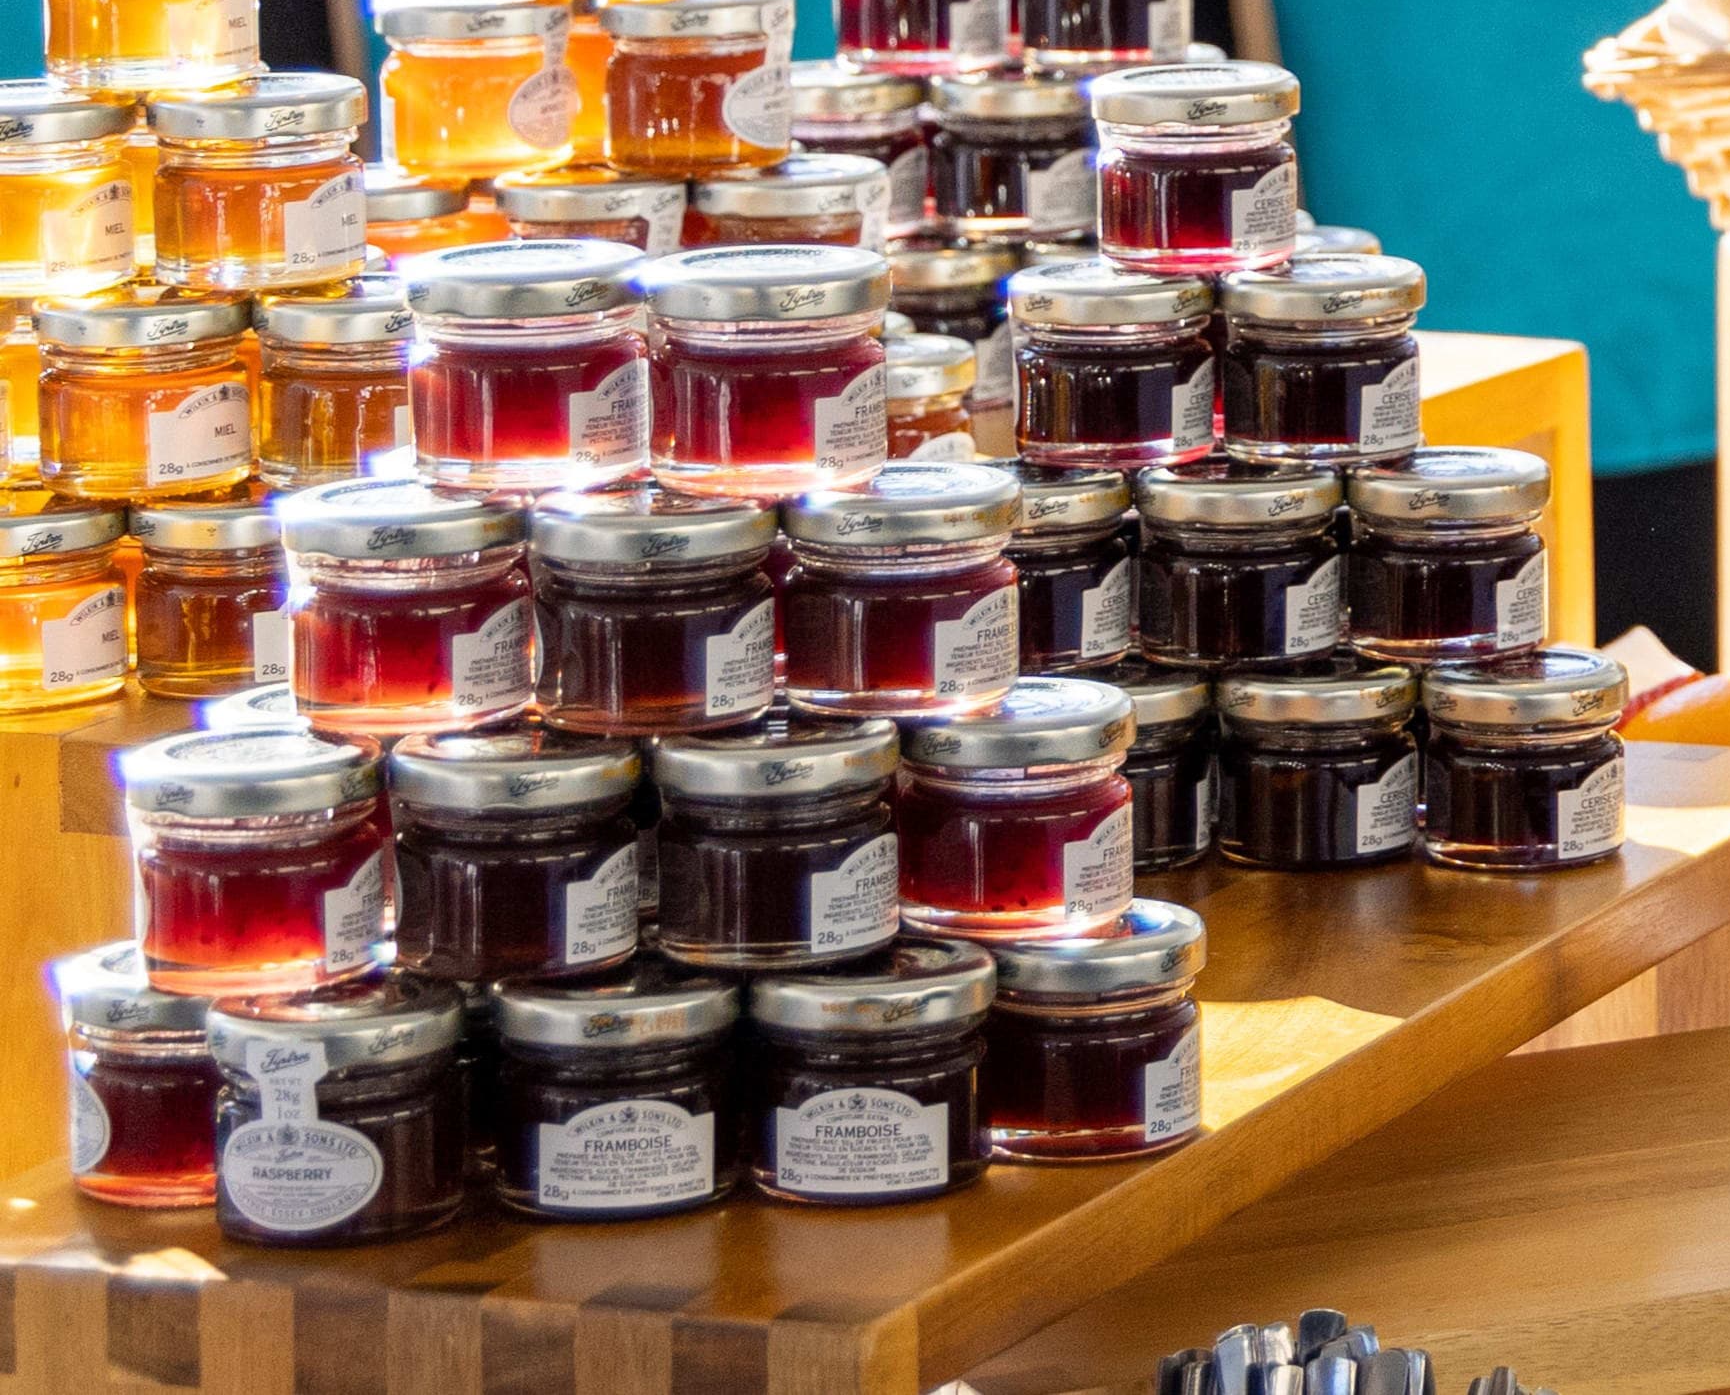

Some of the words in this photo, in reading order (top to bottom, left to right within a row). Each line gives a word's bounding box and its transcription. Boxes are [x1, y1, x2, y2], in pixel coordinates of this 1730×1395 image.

[229, 17, 246, 29] MIEL
[341, 213, 358, 227] MIEL
[105, 223, 125, 236] MIEL
[292, 253, 315, 264] 28g
[214, 423, 236, 438] MIEL
[1174, 436, 1192, 447] 28g
[1363, 434, 1384, 446] 28g
[575, 452, 600, 463] 28g
[820, 457, 844, 469] 28g
[159, 463, 184, 475] 28g
[102, 629, 120, 644] MIEL
[1290, 636, 1310, 648] 28g
[1501, 631, 1520, 642] 28g
[1086, 639, 1105, 651] 28g
[262, 664, 286, 676] 28g
[50, 671, 74, 683] 28g
[940, 680, 965, 693] 28g
[458, 695, 483, 706] 28g
[711, 695, 735, 708] 28g
[1362, 835, 1382, 846] 28g
[1562, 841, 1584, 852] 28g
[1070, 900, 1093, 913] 28g
[817, 930, 844, 945] 28g
[571, 942, 596, 955] 28g
[332, 950, 354, 963] 28g
[274, 1089, 301, 1105] 28g
[806, 1102, 833, 1119] WILKIN
[871, 1097, 896, 1111] SONS
[897, 1104, 912, 1118] LTD
[575, 1116, 605, 1135] WILKIN
[642, 1109, 665, 1124] SONS
[666, 1115, 682, 1129] LTD
[1150, 1120, 1172, 1133] 28g
[815, 1123, 902, 1139] FRAMBOISE
[304, 1133, 335, 1147] SONS
[584, 1135, 672, 1153] FRAMBOISE
[252, 1167, 333, 1182] RASPBERRY
[780, 1168, 803, 1185] 28g
[543, 1184, 570, 1200] 28g
